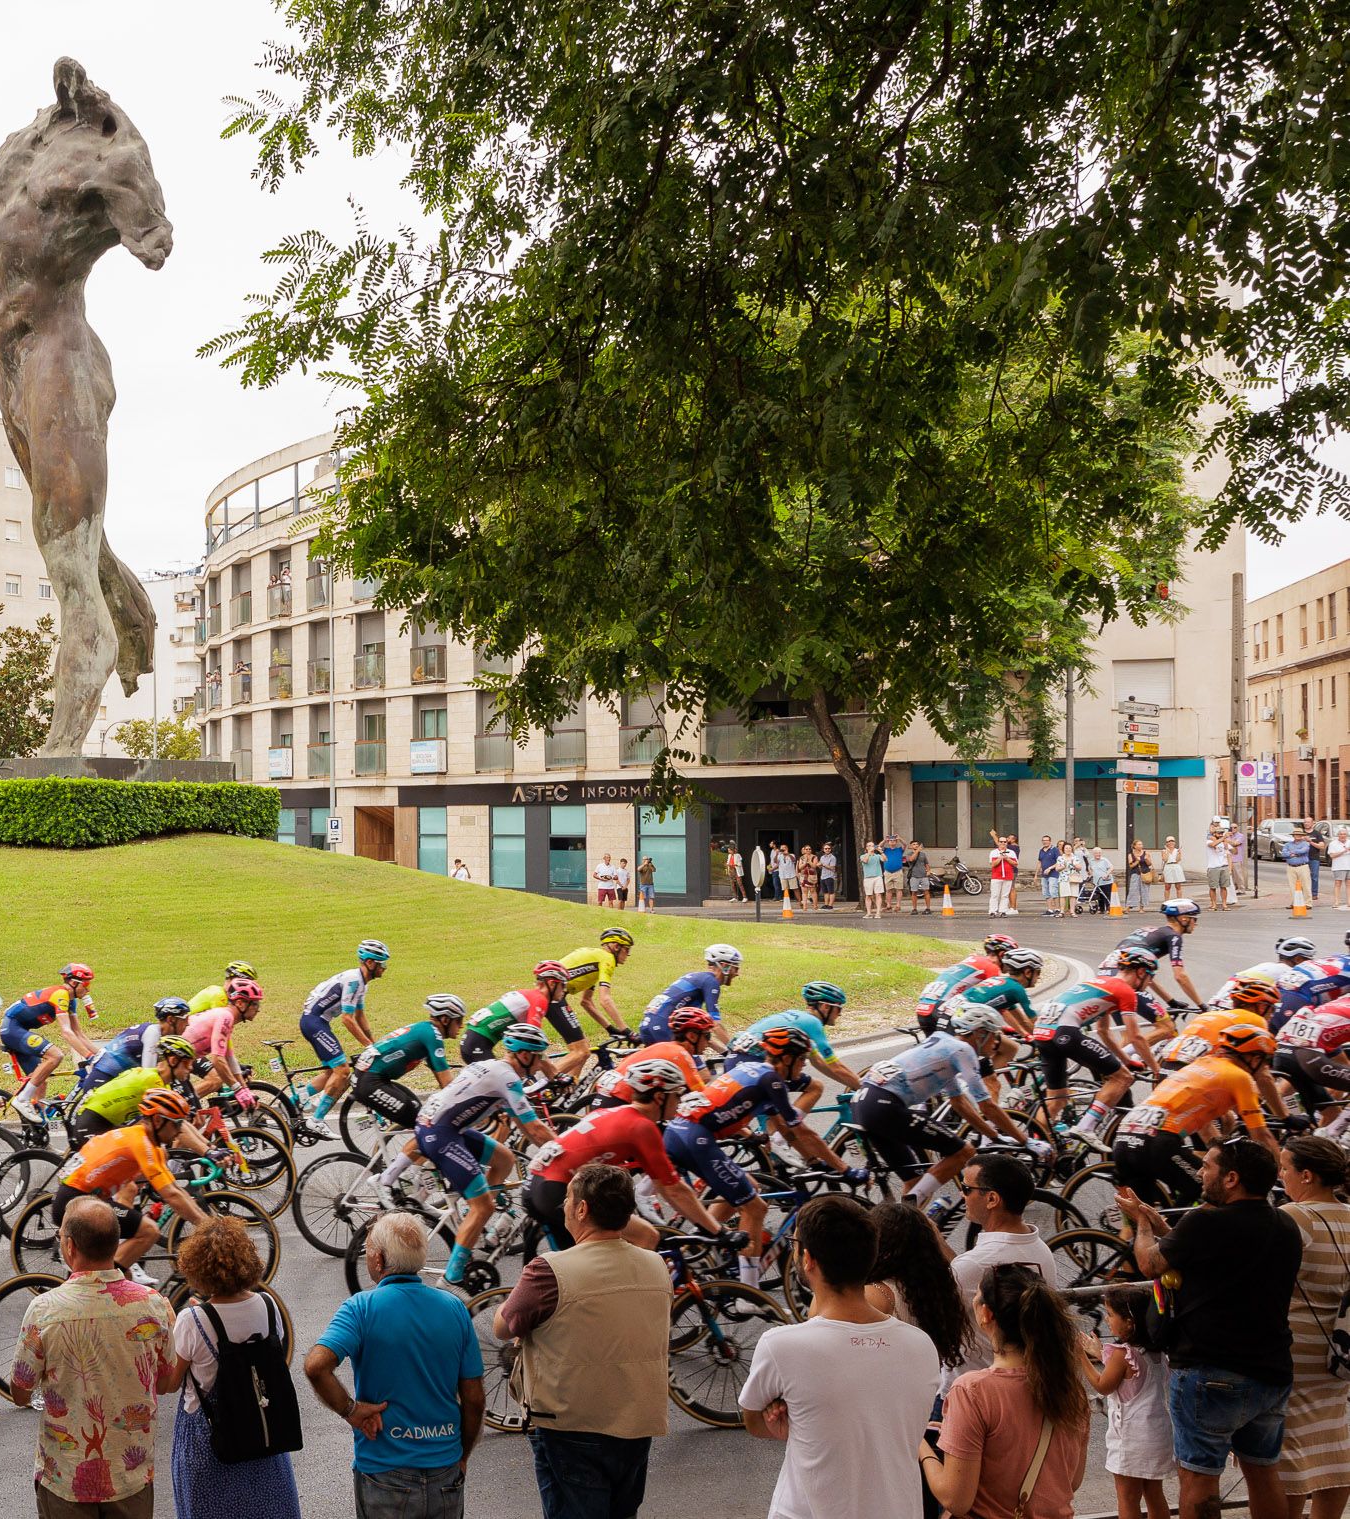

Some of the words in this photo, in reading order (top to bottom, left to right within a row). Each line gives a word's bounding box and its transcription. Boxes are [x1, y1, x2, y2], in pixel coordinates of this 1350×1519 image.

[512, 784, 569, 803] ASTEC
[1291, 1021, 1315, 1039] 181
[373, 1088, 404, 1111] KERN
[451, 1099, 489, 1127] BAHRAIN
[713, 1099, 754, 1125] Jayco
[1136, 1108, 1166, 1126] 213
[390, 1423, 455, 1440] CADIMAR
